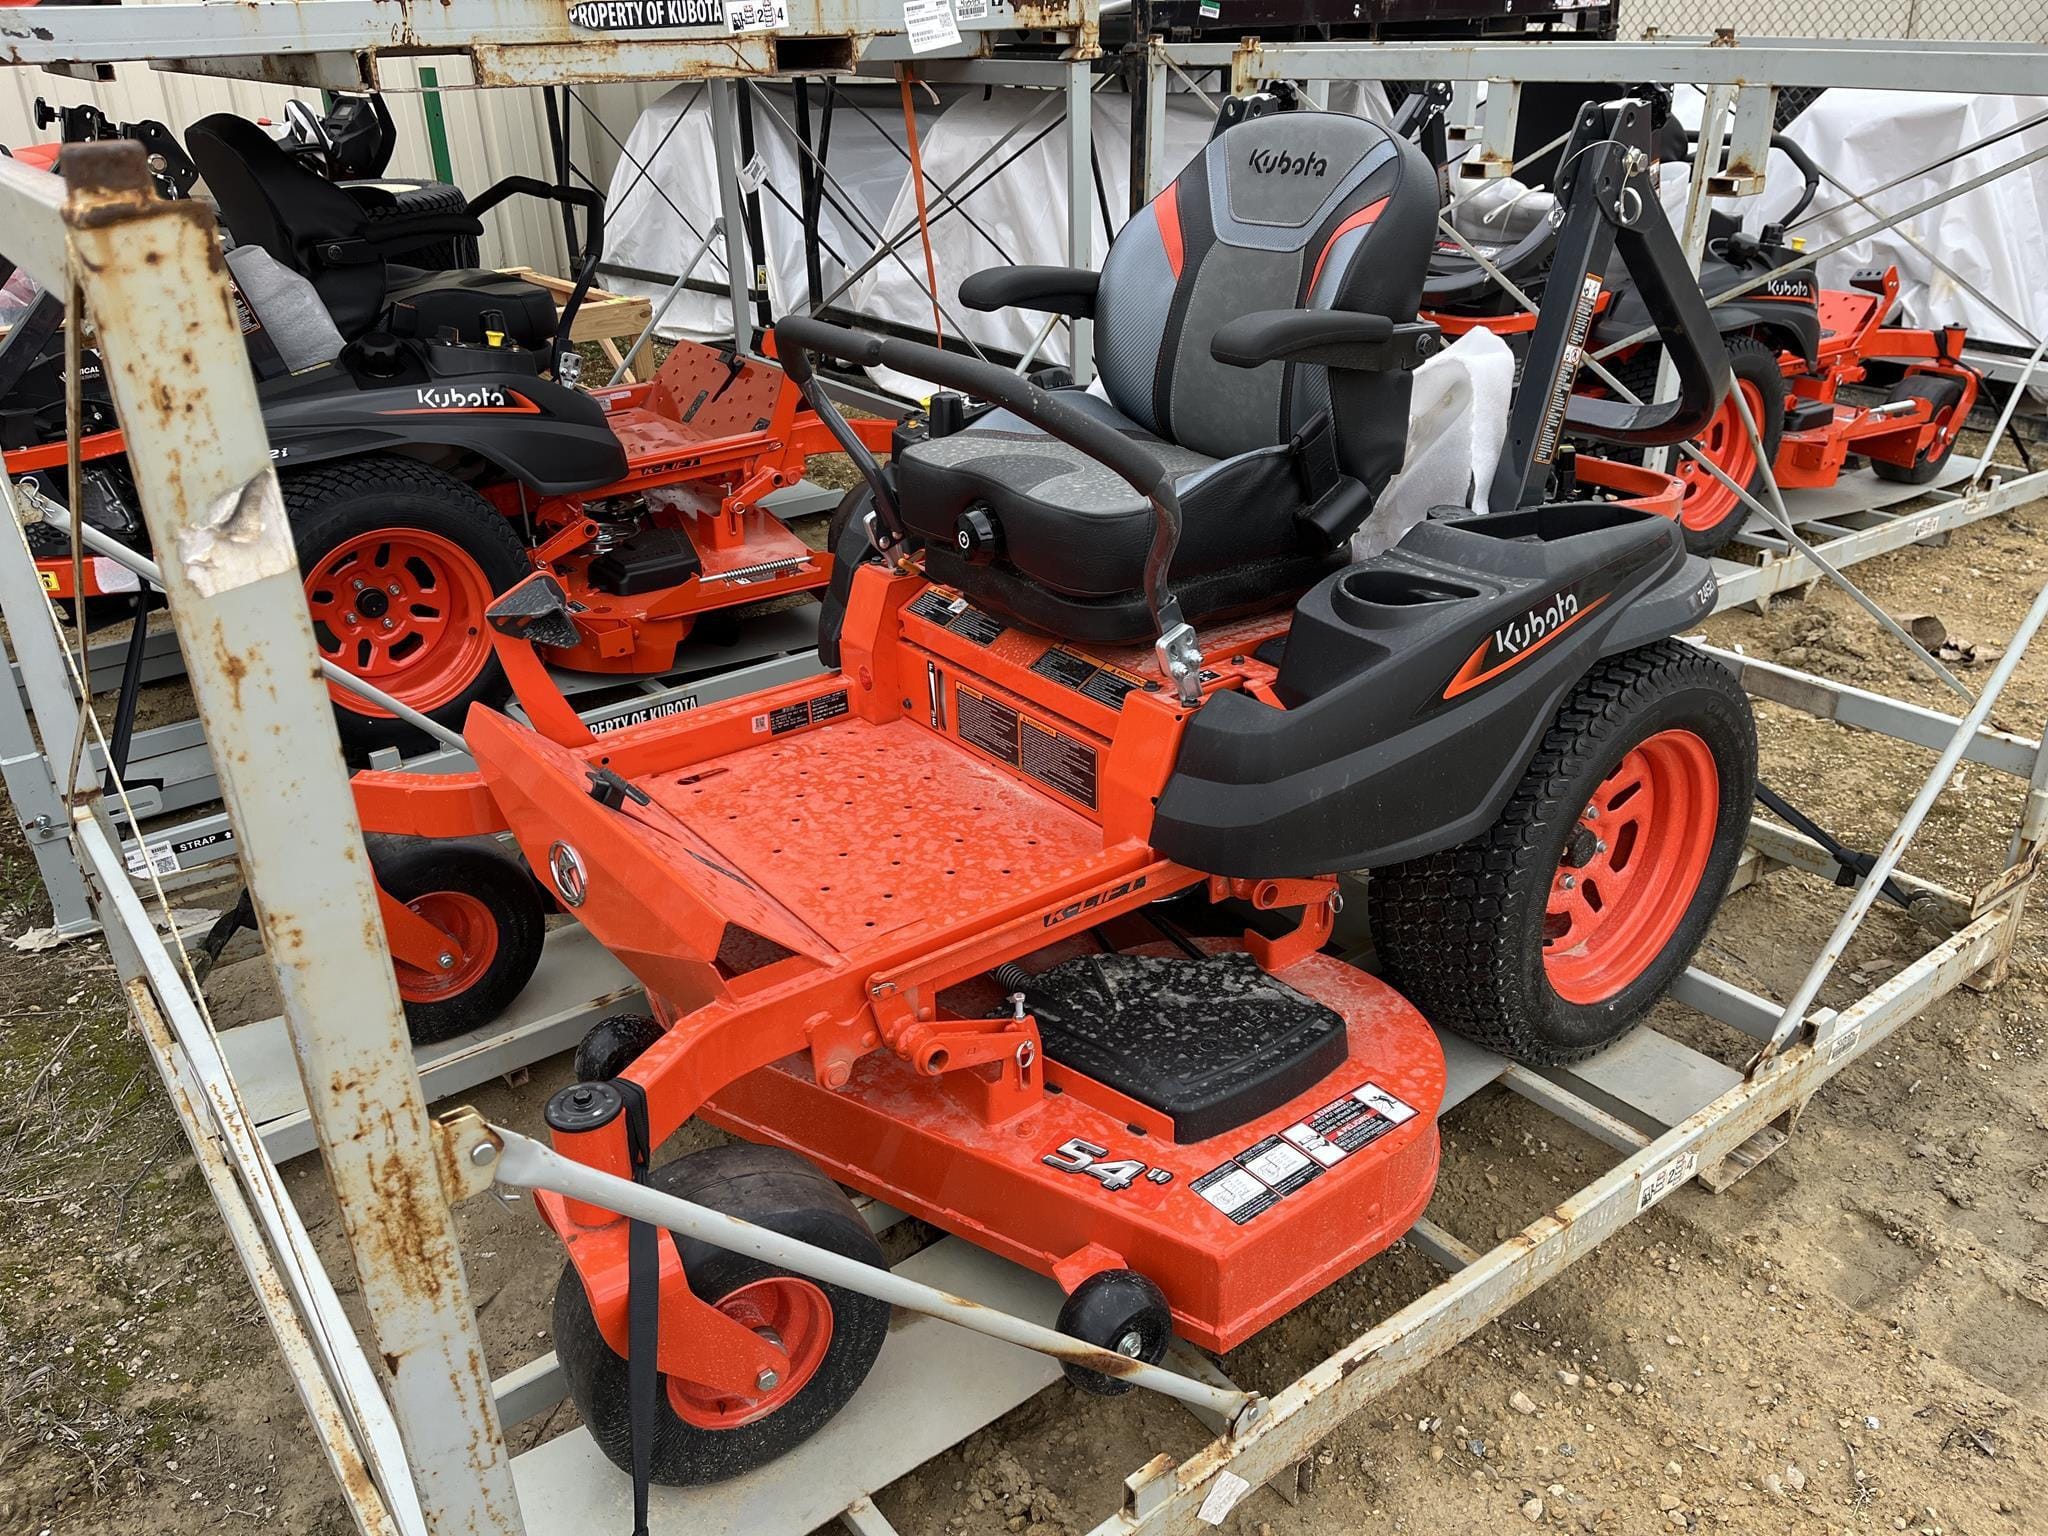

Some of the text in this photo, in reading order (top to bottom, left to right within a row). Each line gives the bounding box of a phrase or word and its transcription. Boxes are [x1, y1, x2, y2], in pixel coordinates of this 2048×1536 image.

[569, 0, 723, 27] PROPERTY OF KUBOTA
[1248, 148, 1327, 177] Kubota
[1767, 279, 1808, 296] Kubota
[416, 386, 505, 408] Kubota
[643, 459, 699, 476] K-LIFT
[1495, 592, 1579, 654] Kubota
[589, 715, 628, 735] PERTY
[631, 710, 647, 726] OF
[179, 835, 216, 852] STRAP
[1319, 1099, 1347, 1117] DANGER
